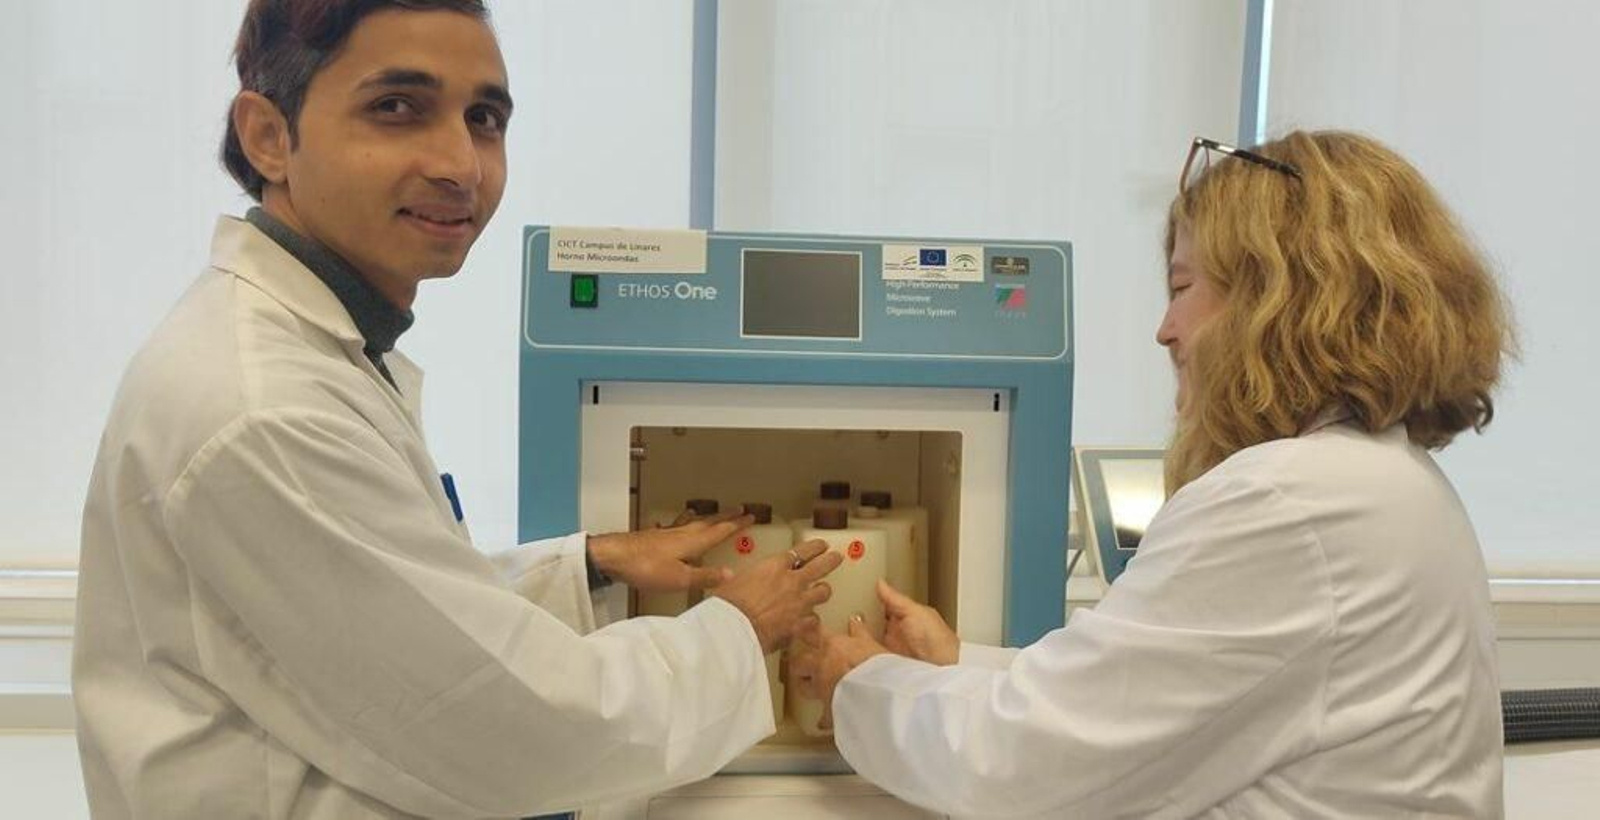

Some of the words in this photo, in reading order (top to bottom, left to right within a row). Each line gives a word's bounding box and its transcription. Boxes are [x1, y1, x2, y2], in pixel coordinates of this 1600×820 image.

[557, 240, 577, 249] CICT
[579, 241, 615, 251] Campus
[617, 242, 628, 251] de
[630, 243, 661, 252] Linares
[557, 252, 585, 261] Horno
[587, 253, 639, 263] Microondas
[618, 283, 671, 299] ETHOS
[674, 281, 718, 300] One
[886, 280, 906, 291] High
[908, 281, 960, 290] Performance
[886, 307, 925, 318] Digestion
[927, 308, 957, 319] System
